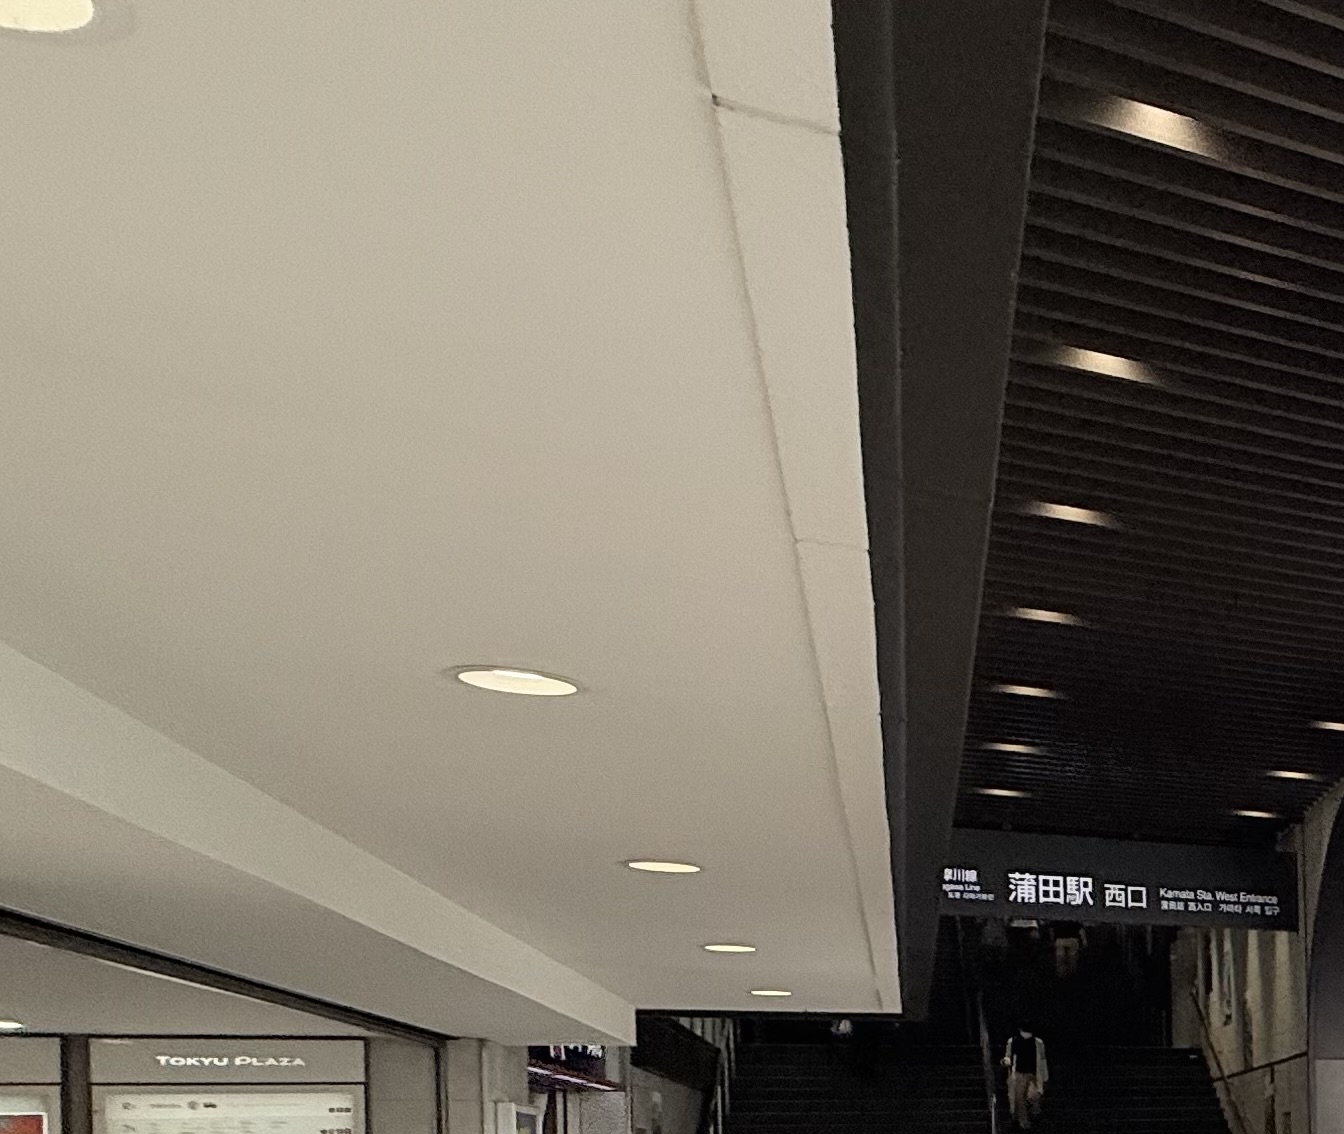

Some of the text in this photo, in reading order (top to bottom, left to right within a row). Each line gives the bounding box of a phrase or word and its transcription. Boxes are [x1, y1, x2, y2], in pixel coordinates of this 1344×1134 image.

[1007, 872, 1148, 909] 蒲田駅 西口
[1159, 887, 1196, 899] Kamata
[1215, 891, 1239, 902] West
[1239, 892, 1279, 905] Entrance
[156, 1055, 305, 1067] TOKYU PLAZA
